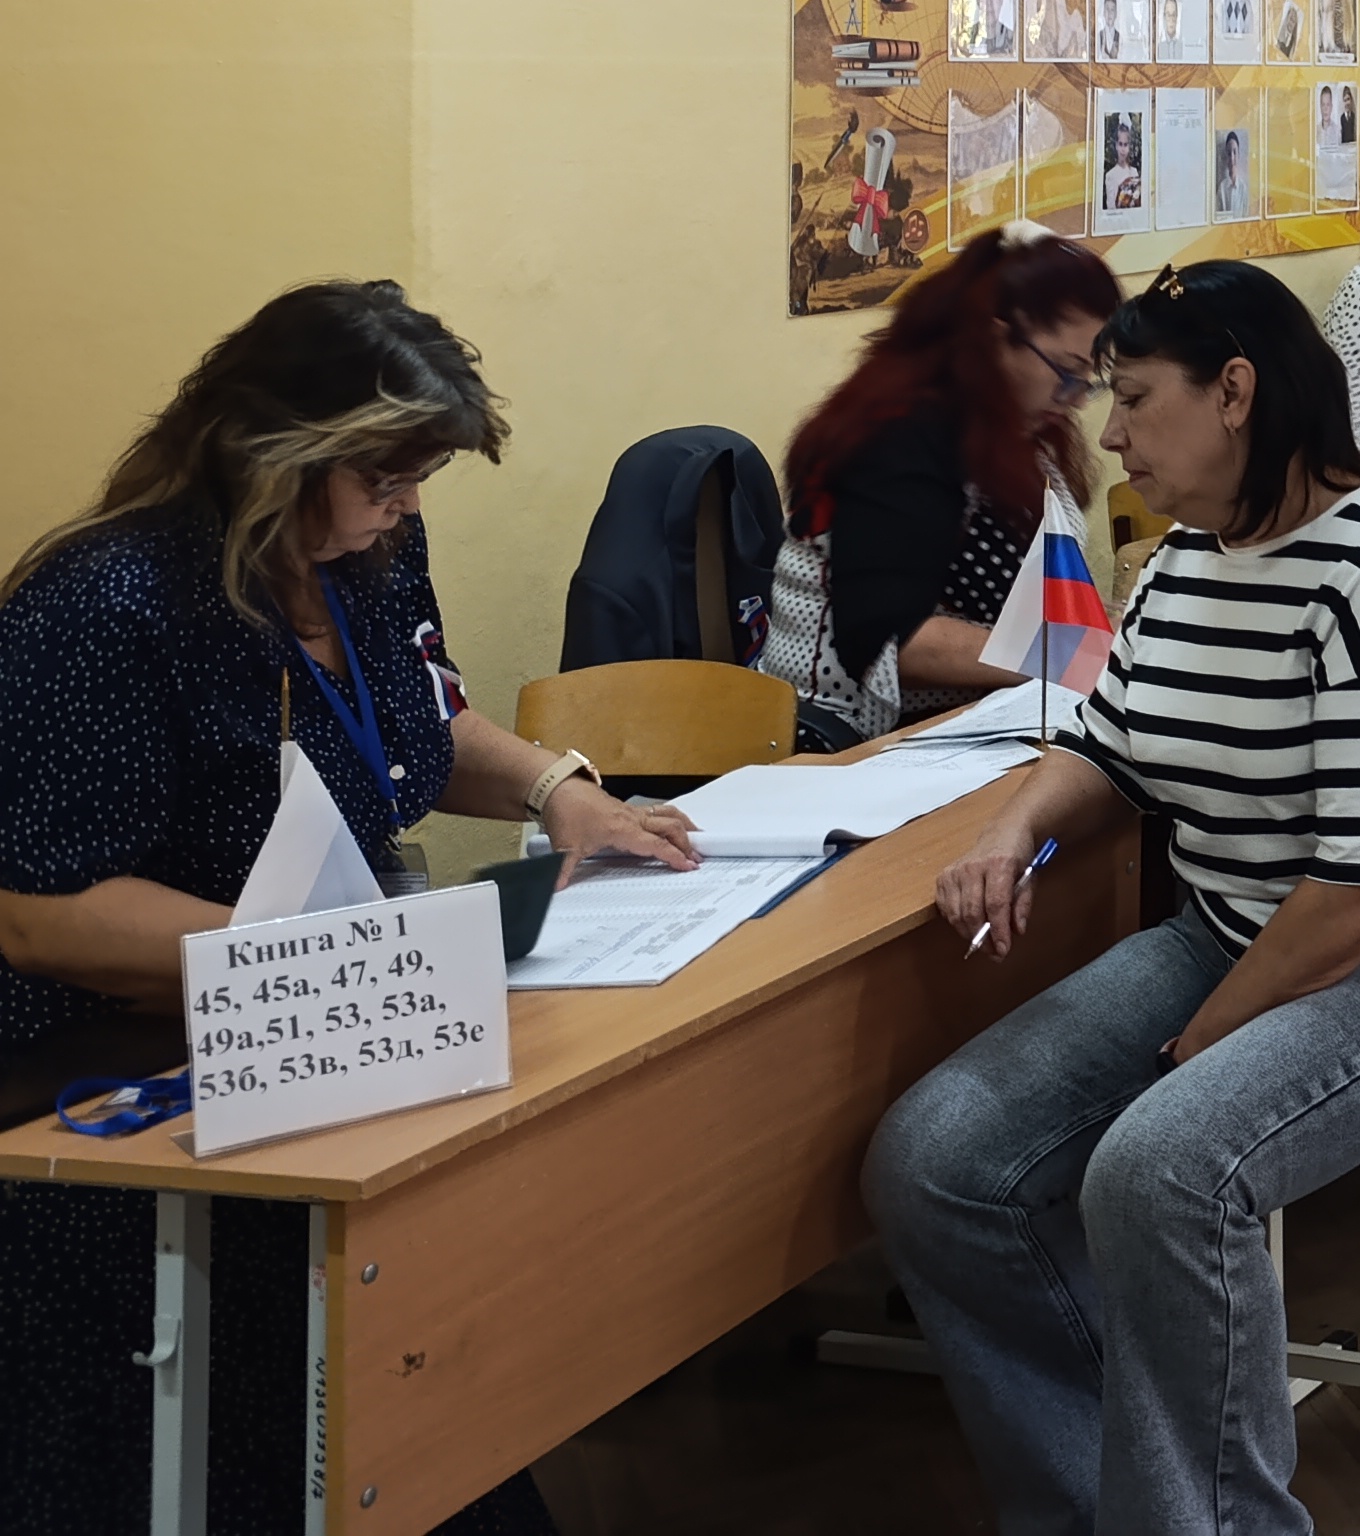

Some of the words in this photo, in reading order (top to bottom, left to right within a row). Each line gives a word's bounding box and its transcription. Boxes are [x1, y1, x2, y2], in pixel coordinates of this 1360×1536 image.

[226, 930, 335, 970] Книга
[346, 918, 384, 947] №
[395, 913, 409, 938] 1
[193, 986, 243, 1016] 45,
[253, 974, 321, 1006] 45а,
[331, 960, 378, 990] 47,
[387, 950, 434, 978] 49,
[325, 1002, 372, 1032] 53,
[382, 990, 447, 1021] 53а,
[198, 1064, 268, 1101] 53б,
[279, 1053, 349, 1085] 53в,
[358, 1036, 424, 1067] 53д,
[434, 1021, 485, 1052] 53е
